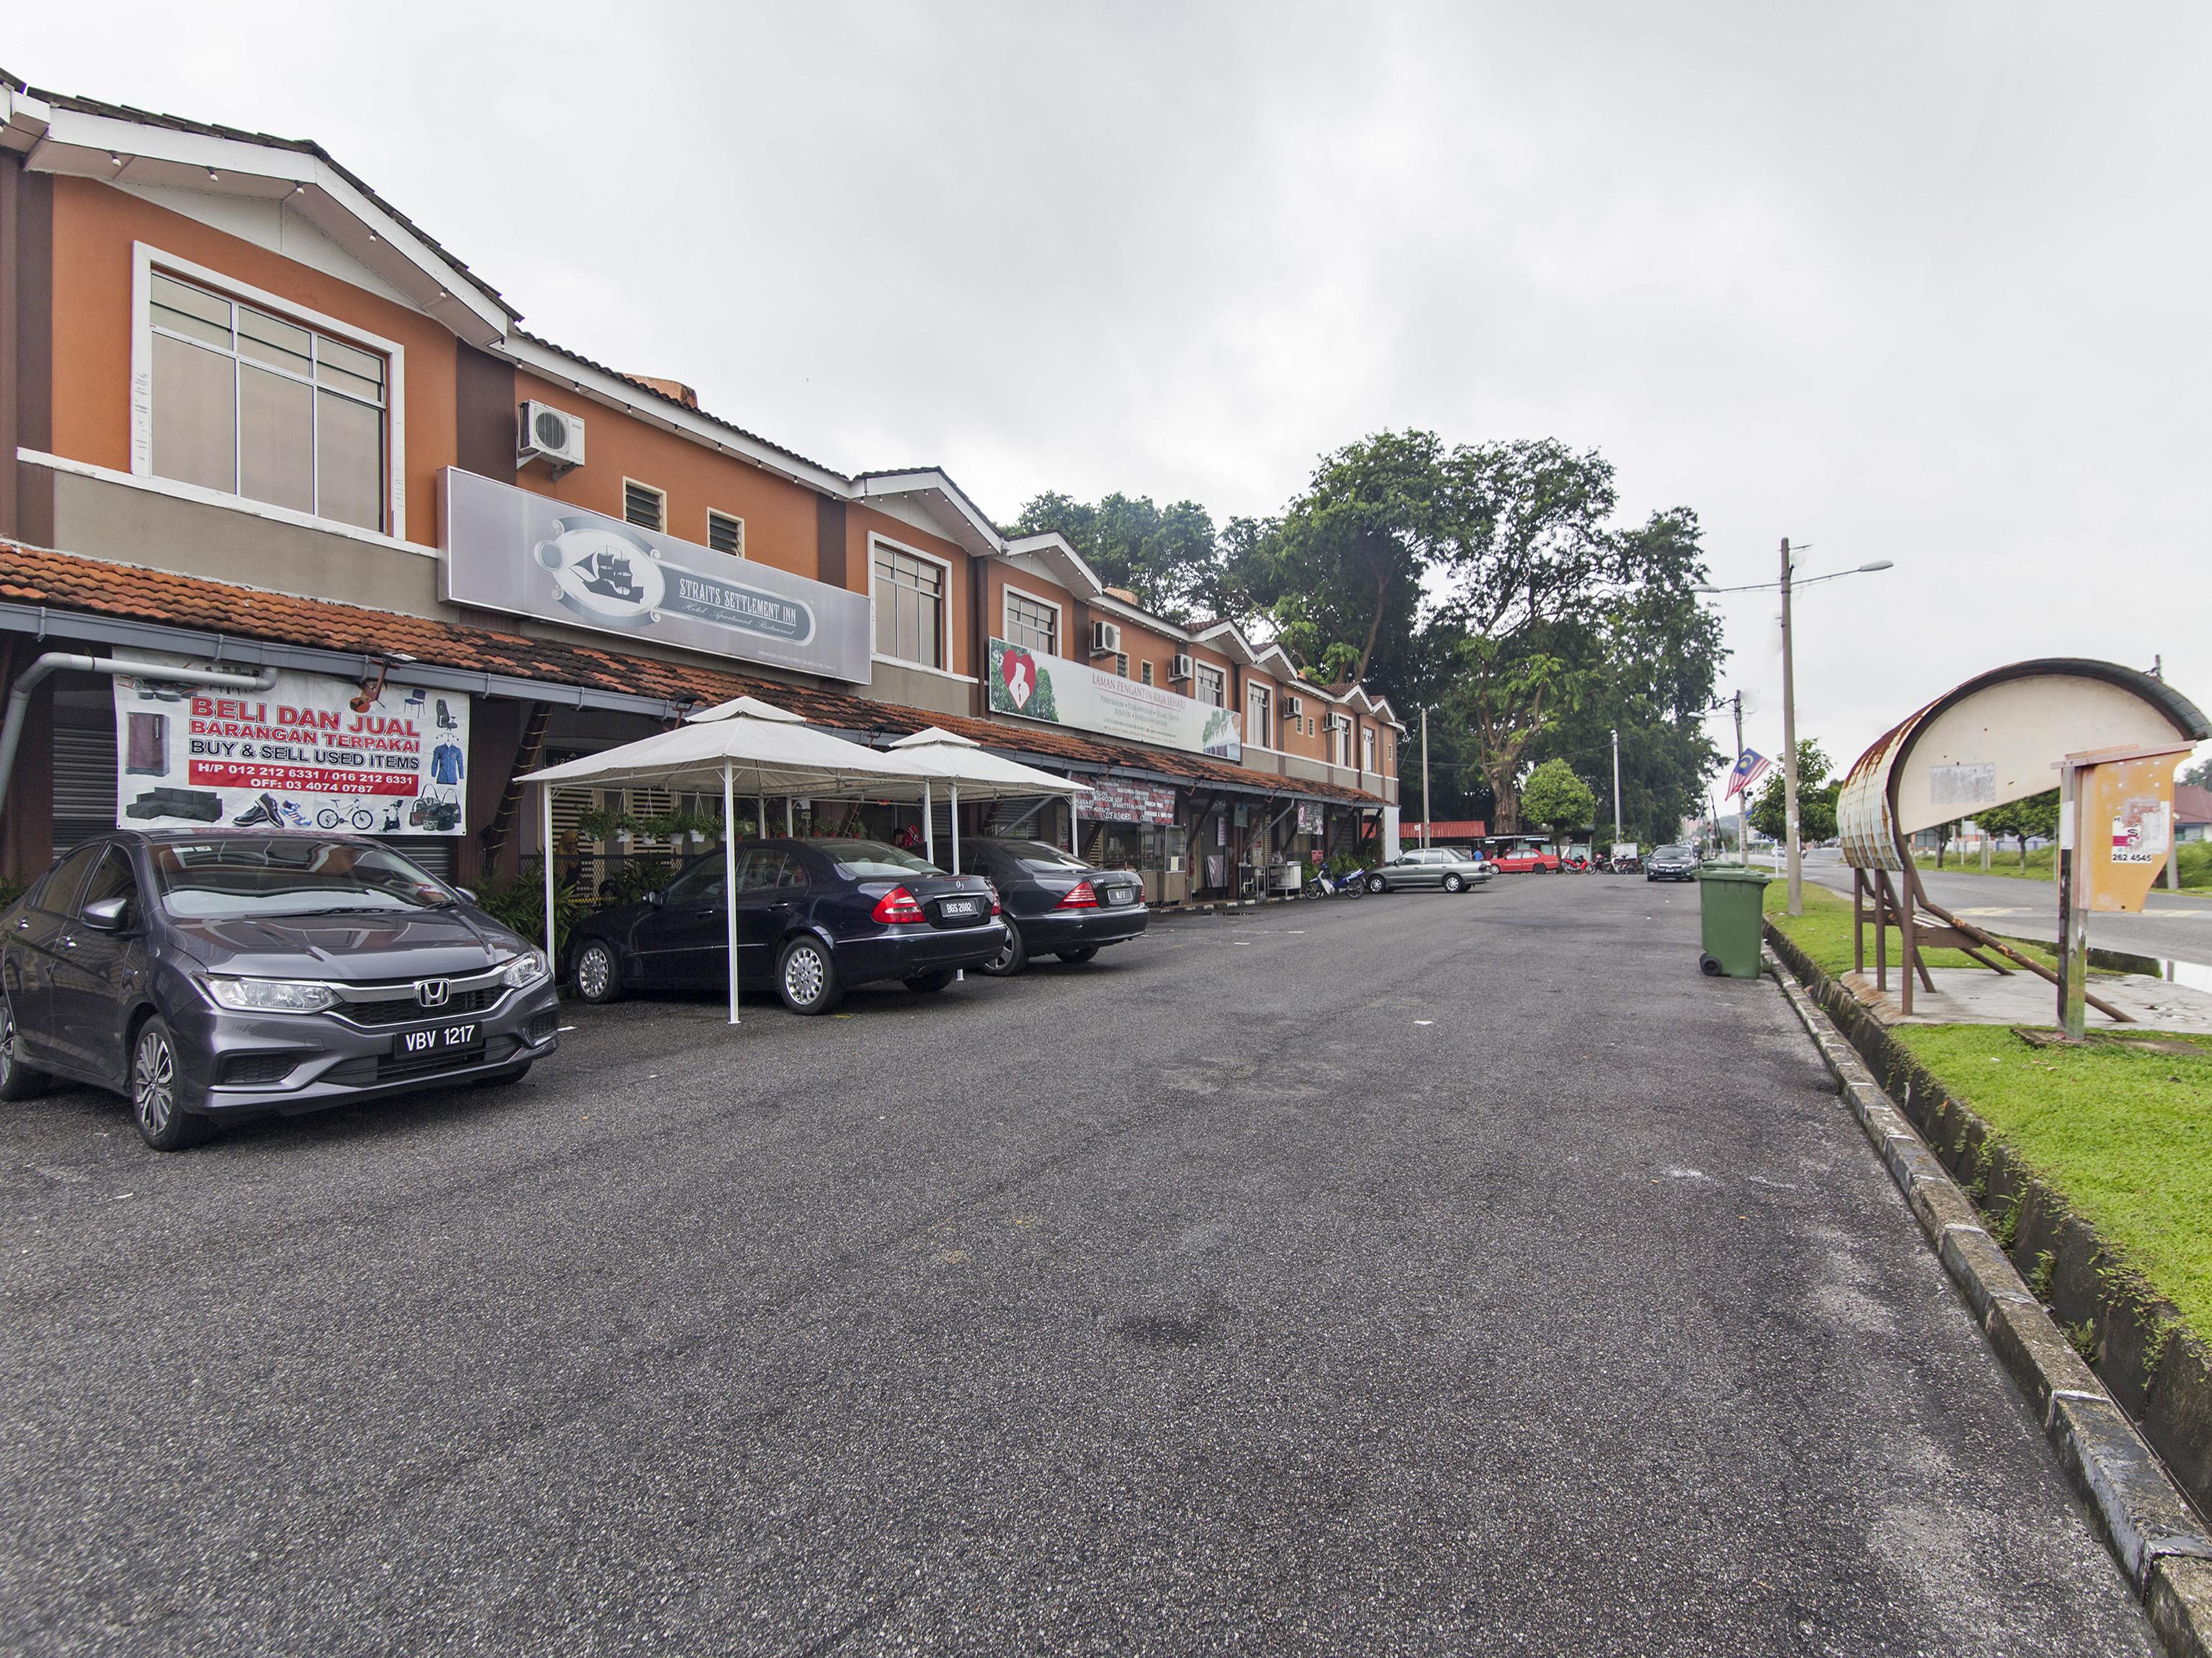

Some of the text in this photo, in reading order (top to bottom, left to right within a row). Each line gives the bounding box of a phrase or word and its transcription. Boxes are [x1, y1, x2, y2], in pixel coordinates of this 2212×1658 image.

[679, 578, 797, 624] STRAITS SETTLEMENT INN
[681, 601, 794, 635] Hotel Apartment Restaurant
[1092, 673, 1185, 710] LAMAN PENGANTIN RAJA SEHARI
[191, 696, 420, 738] BELI DAN JUAL
[189, 718, 420, 753] BARANGAN TERPAKAI
[189, 738, 420, 771] BUY & SELL USED ITEMS
[198, 764, 224, 773] H/P
[229, 766, 255, 775] 012
[259, 768, 284, 777] 212
[289, 769, 319, 779] 6331
[332, 772, 355, 782] 016
[360, 774, 383, 783] 212
[386, 776, 412, 784] 6331
[250, 779, 373, 793] OFF: 03 4074 0787
[406, 1025, 475, 1051] VBV 1217
